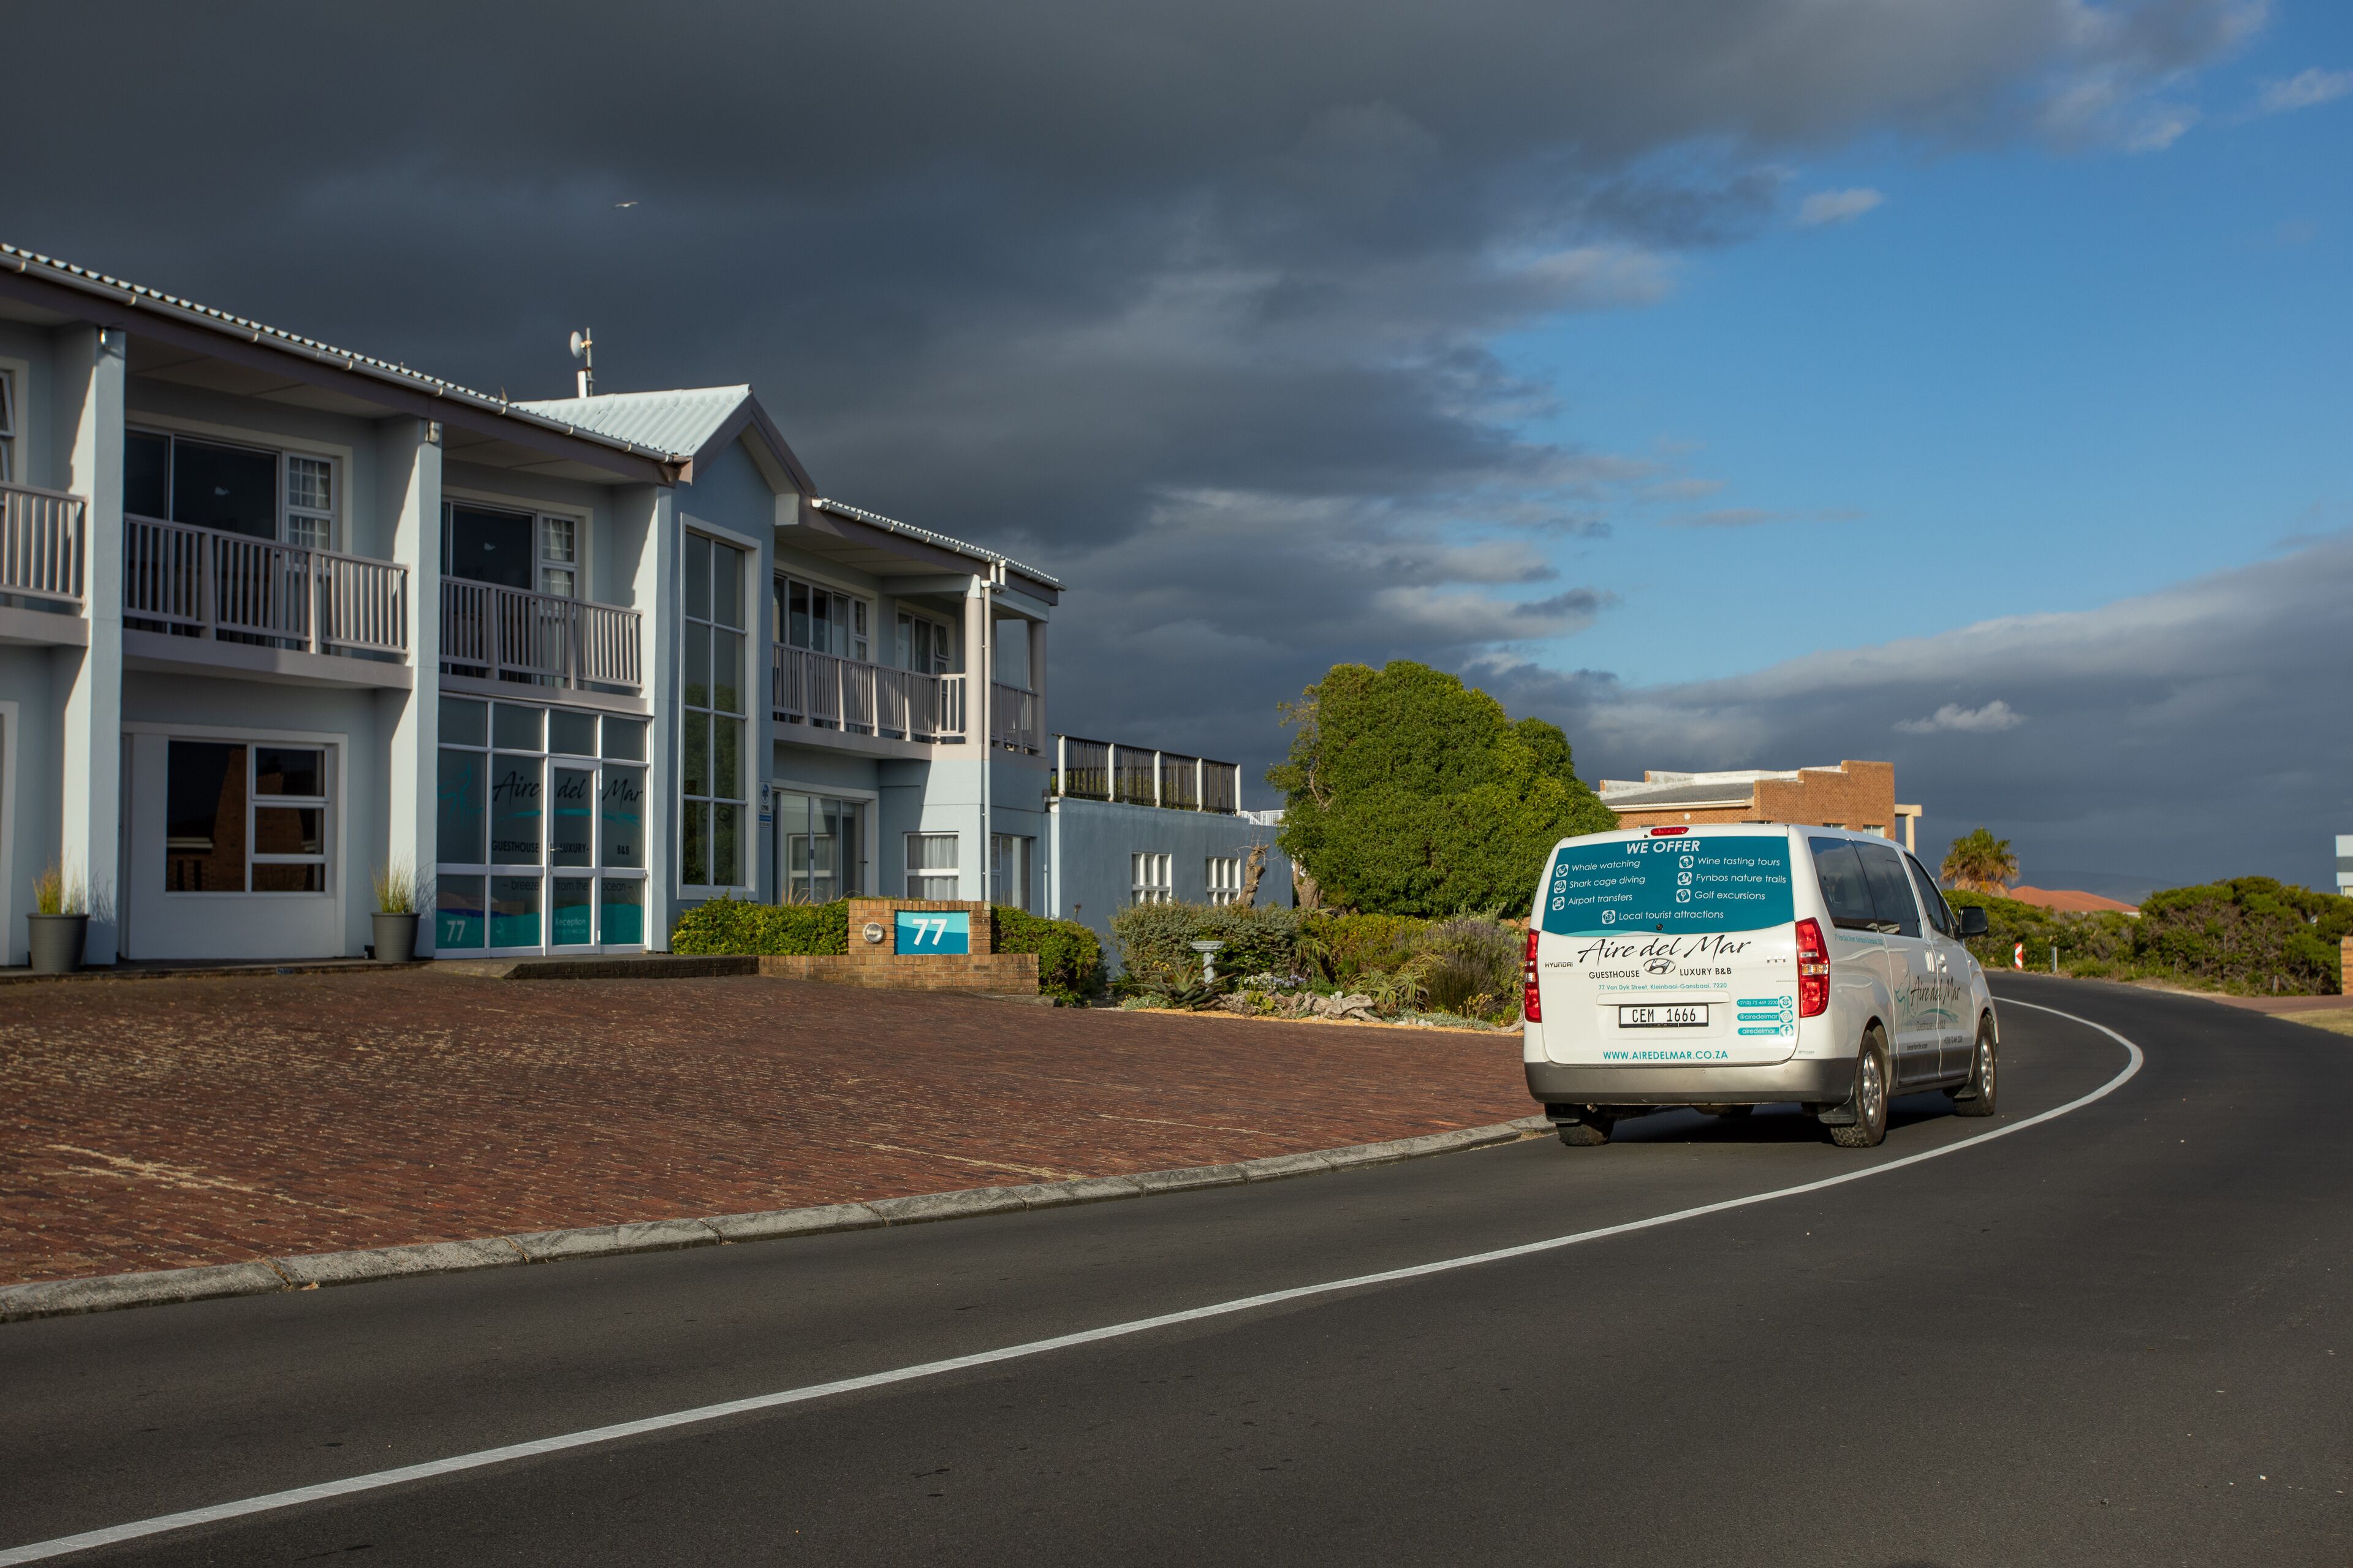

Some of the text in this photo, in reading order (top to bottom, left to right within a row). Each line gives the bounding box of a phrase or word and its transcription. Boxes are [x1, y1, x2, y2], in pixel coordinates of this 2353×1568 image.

[492, 770, 643, 809] Aire del Mar
[491, 840, 540, 853] GUESTHOUSE
[617, 844, 630, 855] B&B
[1626, 840, 1700, 855] WE OFFER
[1572, 860, 1640, 871] Whale watching
[1723, 857, 1755, 867] tasting
[511, 879, 540, 891] breeze
[556, 880, 574, 891] from
[576, 880, 589, 891] the
[601, 882, 626, 892] ocean
[1569, 876, 1646, 888] Shark cage diving
[1696, 874, 1729, 883] Fynbos
[1765, 874, 1786, 884] trails
[1567, 893, 1632, 906] Airport transfers
[1694, 891, 1765, 900] Golf excursions
[1619, 910, 1724, 920] Local tourist attractions
[555, 917, 586, 927] Reception
[447, 920, 466, 942] 77
[912, 918, 947, 946] 77
[1578, 934, 1751, 966] Aire del Mar
[1589, 970, 1640, 979] GUESTHOUSE
[1910, 975, 1961, 1010] Aire del Mar
[1632, 1008, 1696, 1023] CEM 1666
[1603, 1050, 1729, 1059] WWW.AIREDELMAR.CO.ZA
